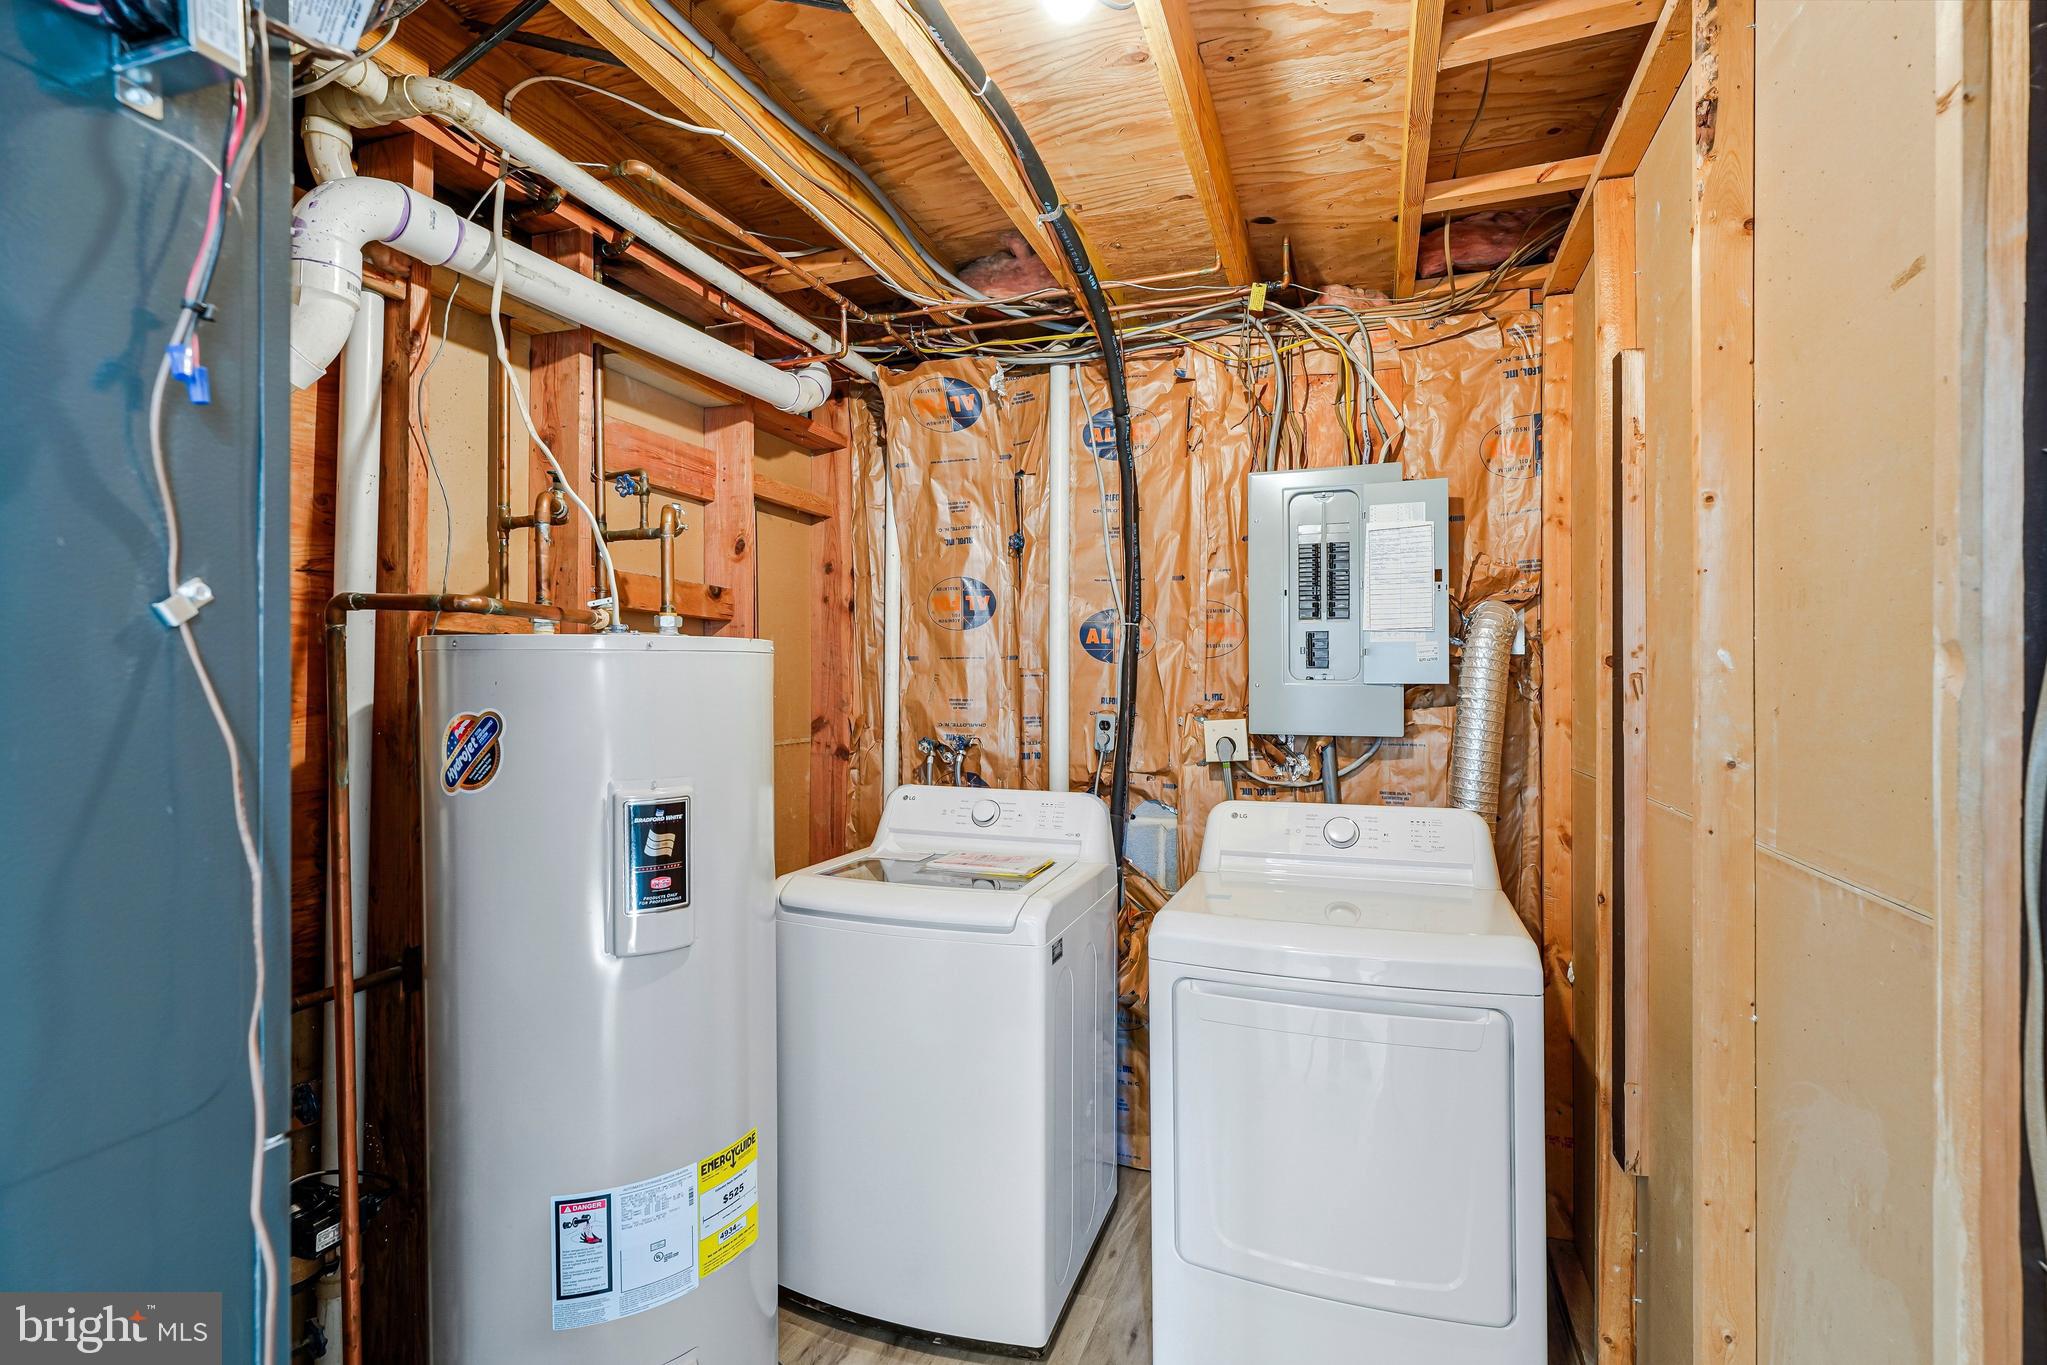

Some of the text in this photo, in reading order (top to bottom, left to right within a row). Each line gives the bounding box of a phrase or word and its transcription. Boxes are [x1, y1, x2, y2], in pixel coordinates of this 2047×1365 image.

[447, 736, 478, 783] Hydrojet
[634, 816, 665, 824] BRADFORD
[649, 896, 682, 905] PROFESSIONALS
[701, 1132, 756, 1176] ENERGYGUIDE
[723, 1182, 744, 1204] $525
[573, 1201, 602, 1211] DANGER
[720, 1224, 737, 1240] 4934
